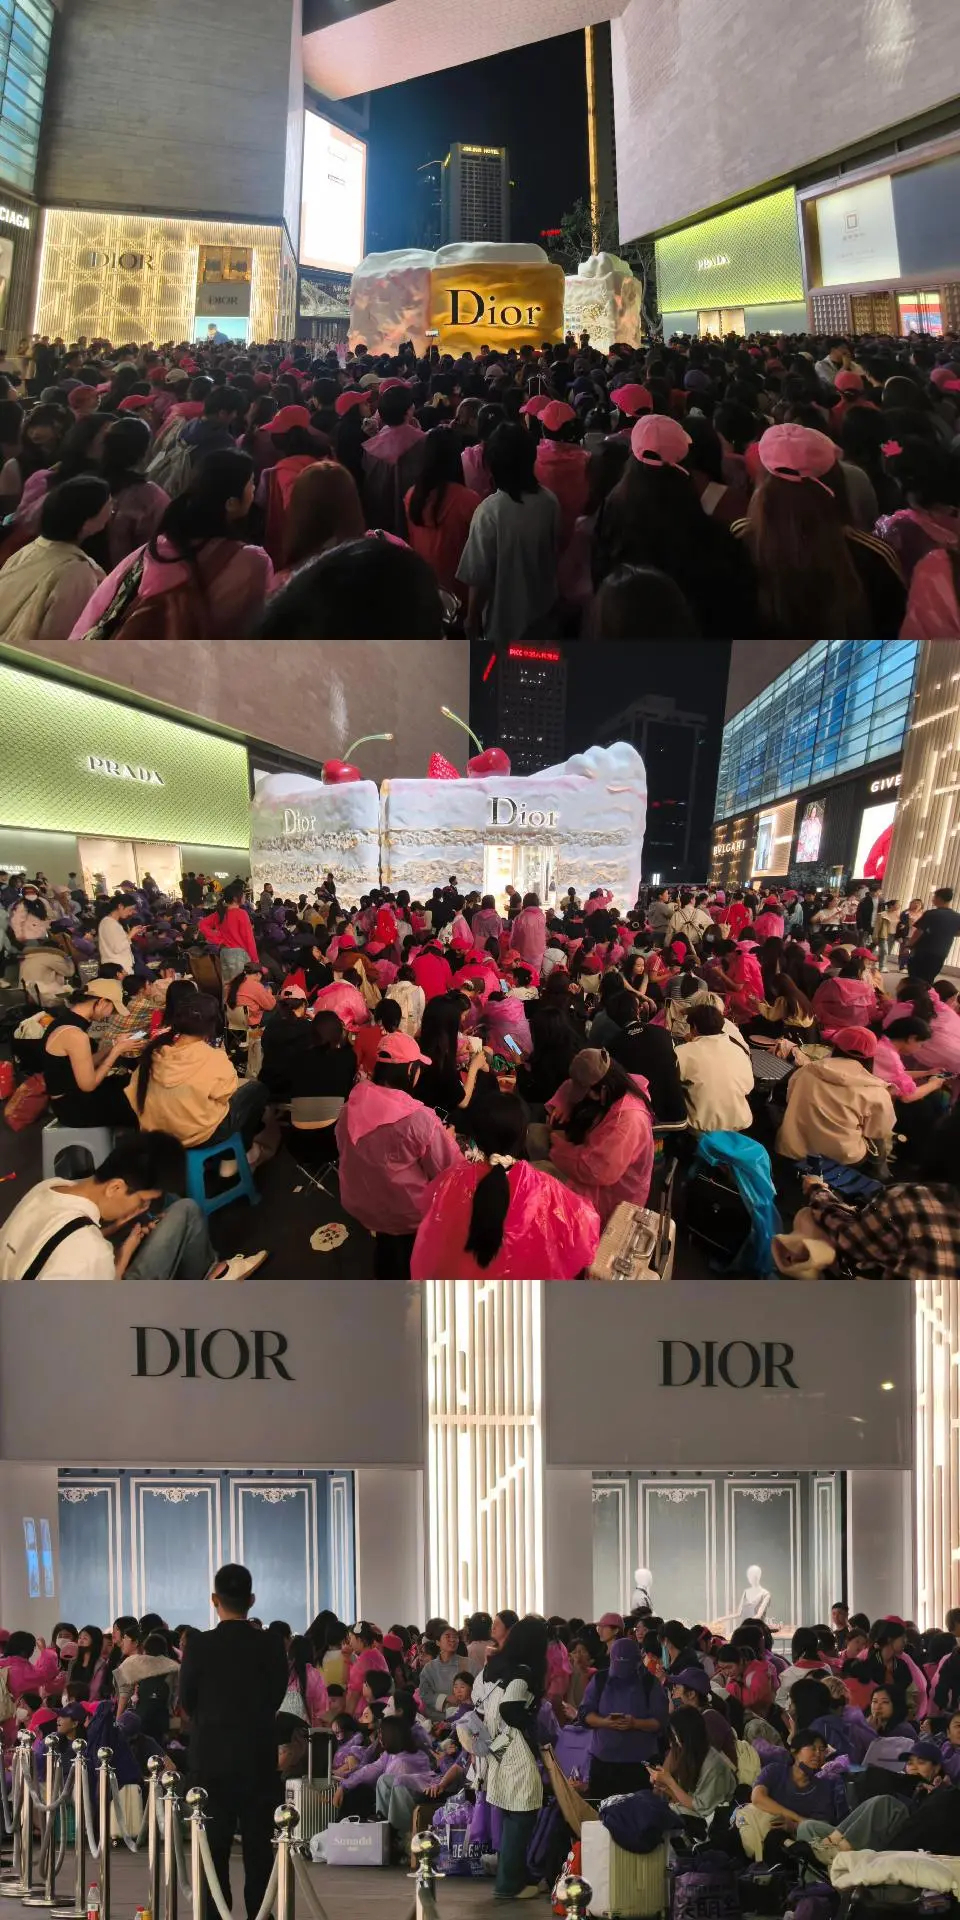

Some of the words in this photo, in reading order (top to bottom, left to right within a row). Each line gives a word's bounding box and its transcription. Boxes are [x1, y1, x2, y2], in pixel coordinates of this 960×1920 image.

[90, 251, 153, 270] DIOR
[209, 295, 239, 305] DIOR
[444, 290, 541, 325] Dior
[87, 756, 164, 785] PRADA
[871, 774, 902, 792] GIVE
[284, 808, 317, 834] Dior
[489, 797, 557, 827] Dior
[130, 1326, 296, 1380] DIOR
[657, 1340, 799, 1389] DIOR
